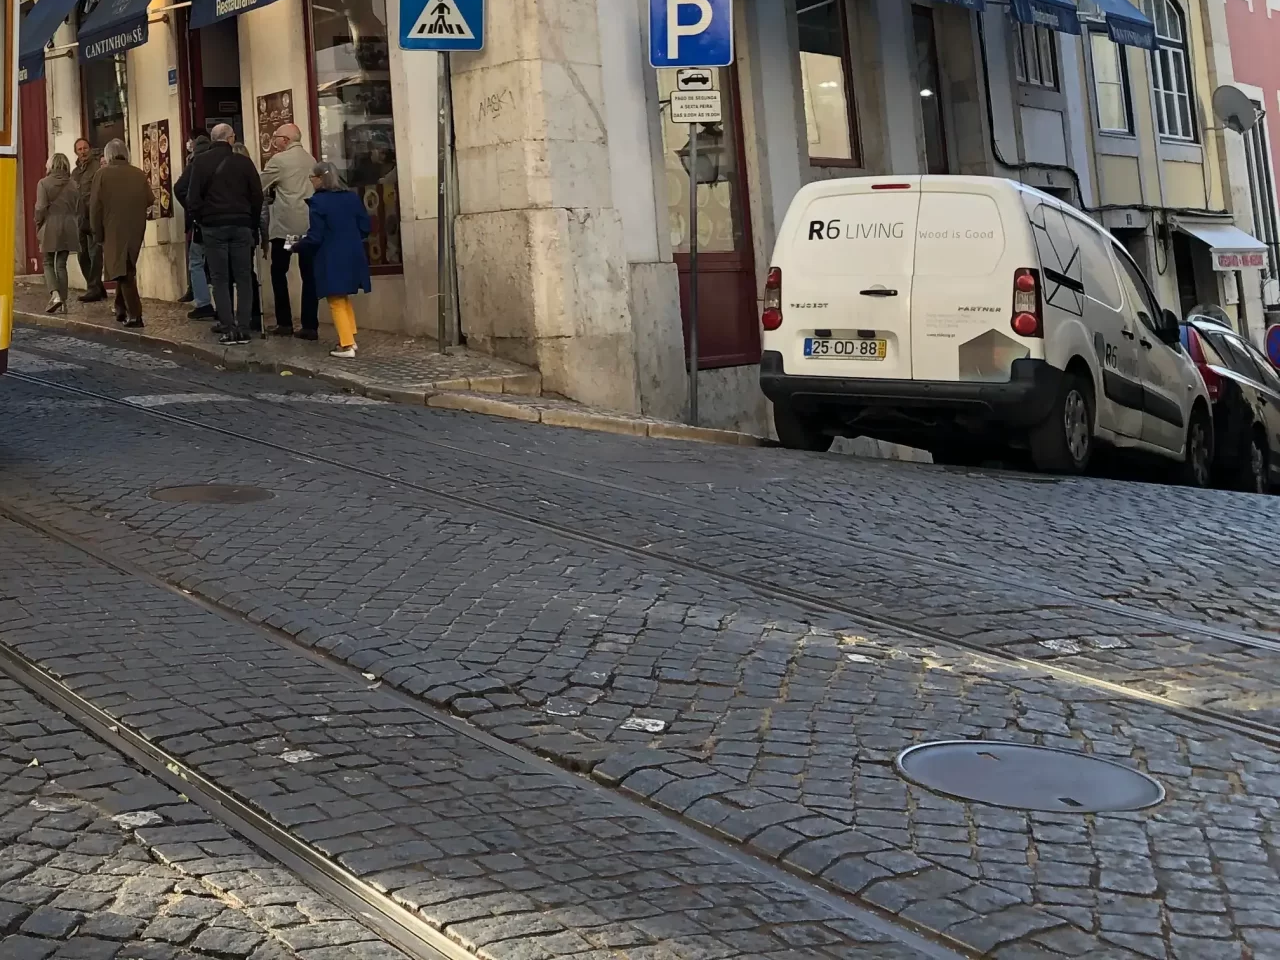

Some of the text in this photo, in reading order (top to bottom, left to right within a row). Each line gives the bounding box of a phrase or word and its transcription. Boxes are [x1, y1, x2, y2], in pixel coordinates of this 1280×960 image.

[85, 33, 127, 59] CANTINHO
[132, 24, 144, 43] SÉ
[808, 219, 904, 240] R6 LIVING
[919, 229, 994, 239] Wood is Good
[1106, 343, 1118, 369] R6
